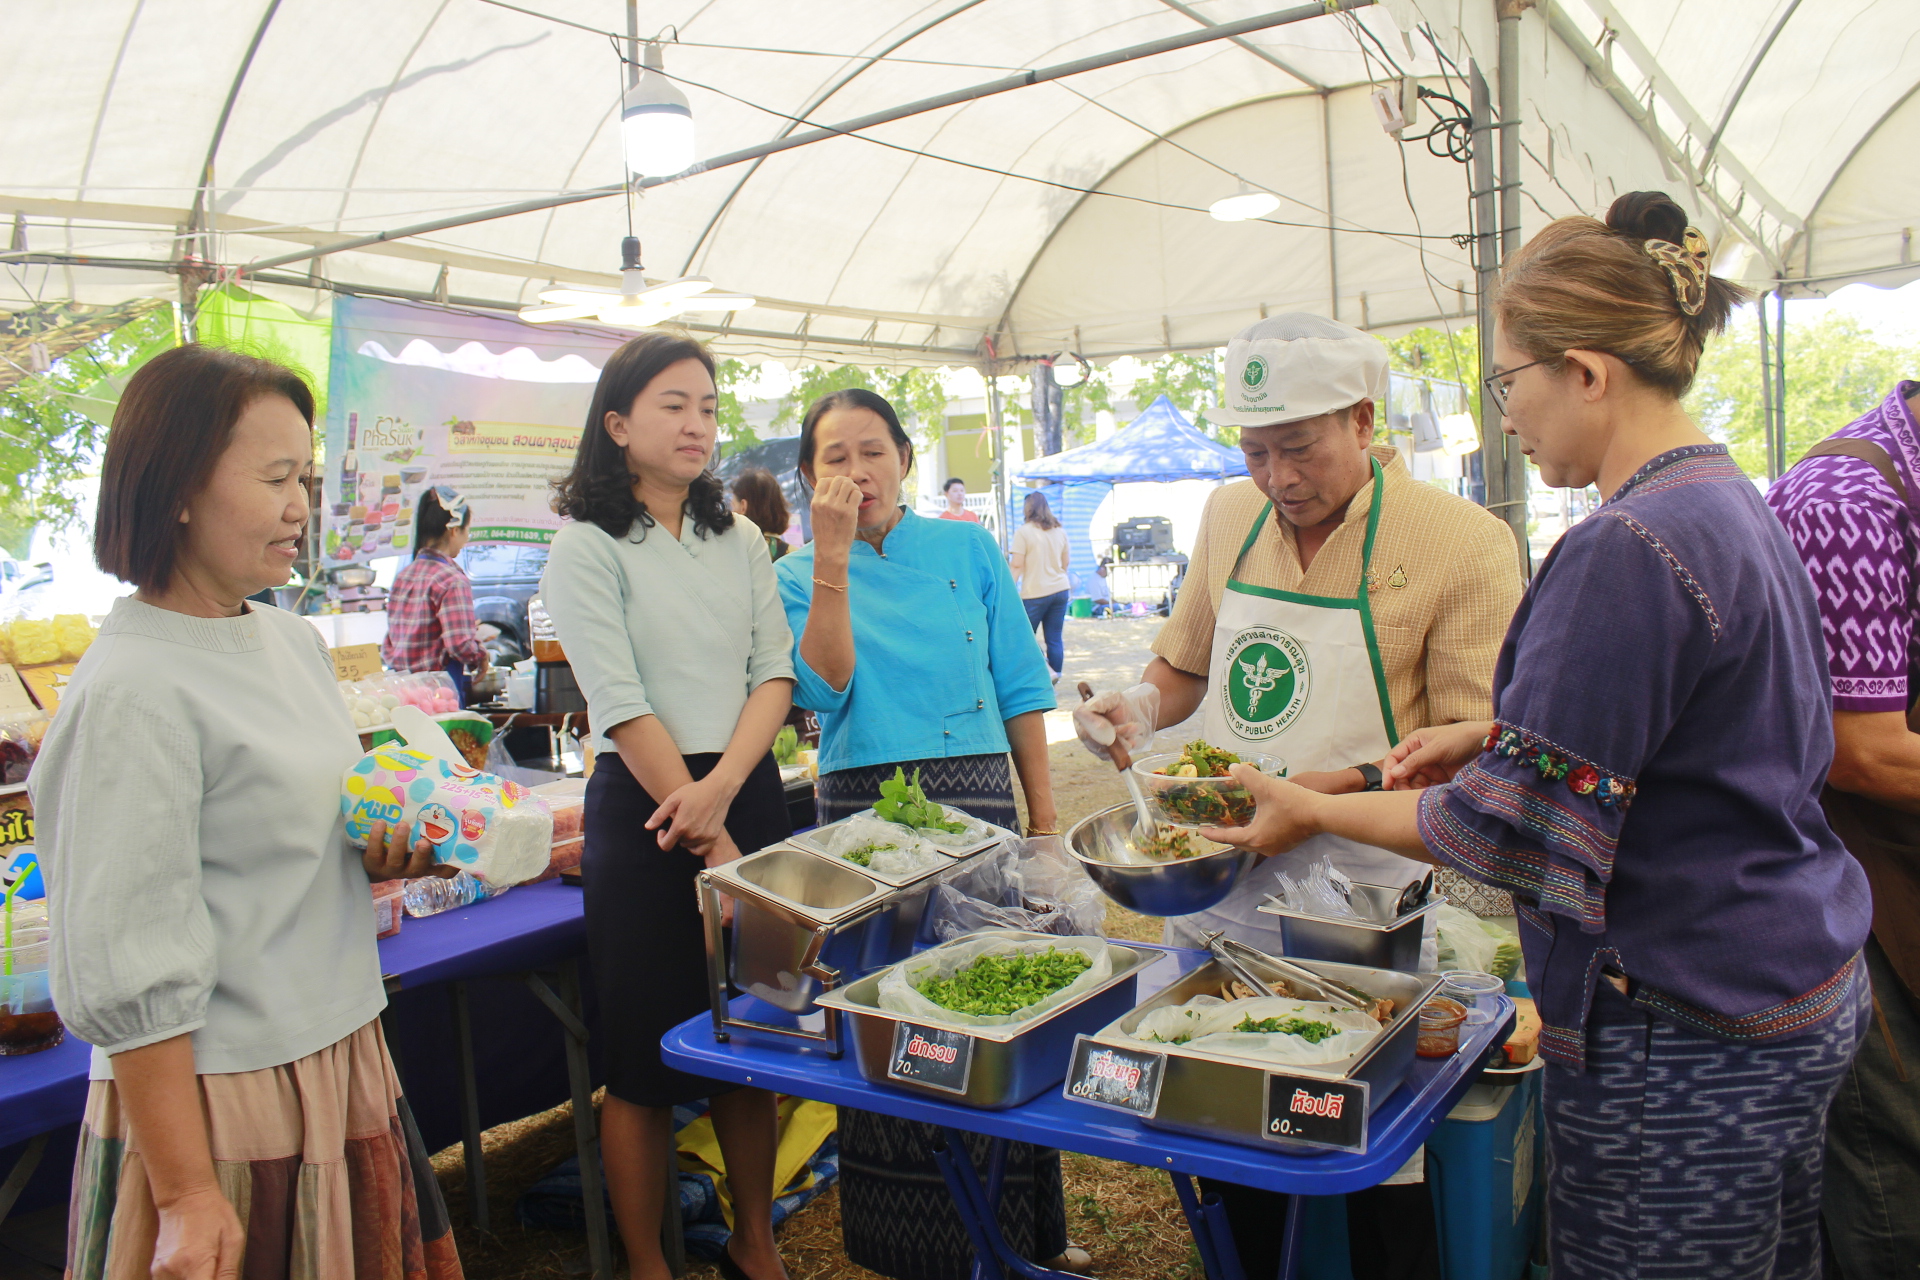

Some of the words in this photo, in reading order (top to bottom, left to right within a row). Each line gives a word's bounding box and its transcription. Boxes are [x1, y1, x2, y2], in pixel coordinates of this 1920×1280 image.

[1223, 684, 1235, 722] MINISTRY
[1235, 721, 1244, 730] OF
[1245, 724, 1274, 735] PUBLIC
[1275, 698, 1301, 728] HEALTH
[440, 781, 482, 799] 225+15
[908, 1033, 957, 1064] ผักรวม
[895, 1059, 920, 1075] 70.-
[1290, 1088, 1344, 1119] หัวปลี
[1270, 1118, 1303, 1134] 60.-
